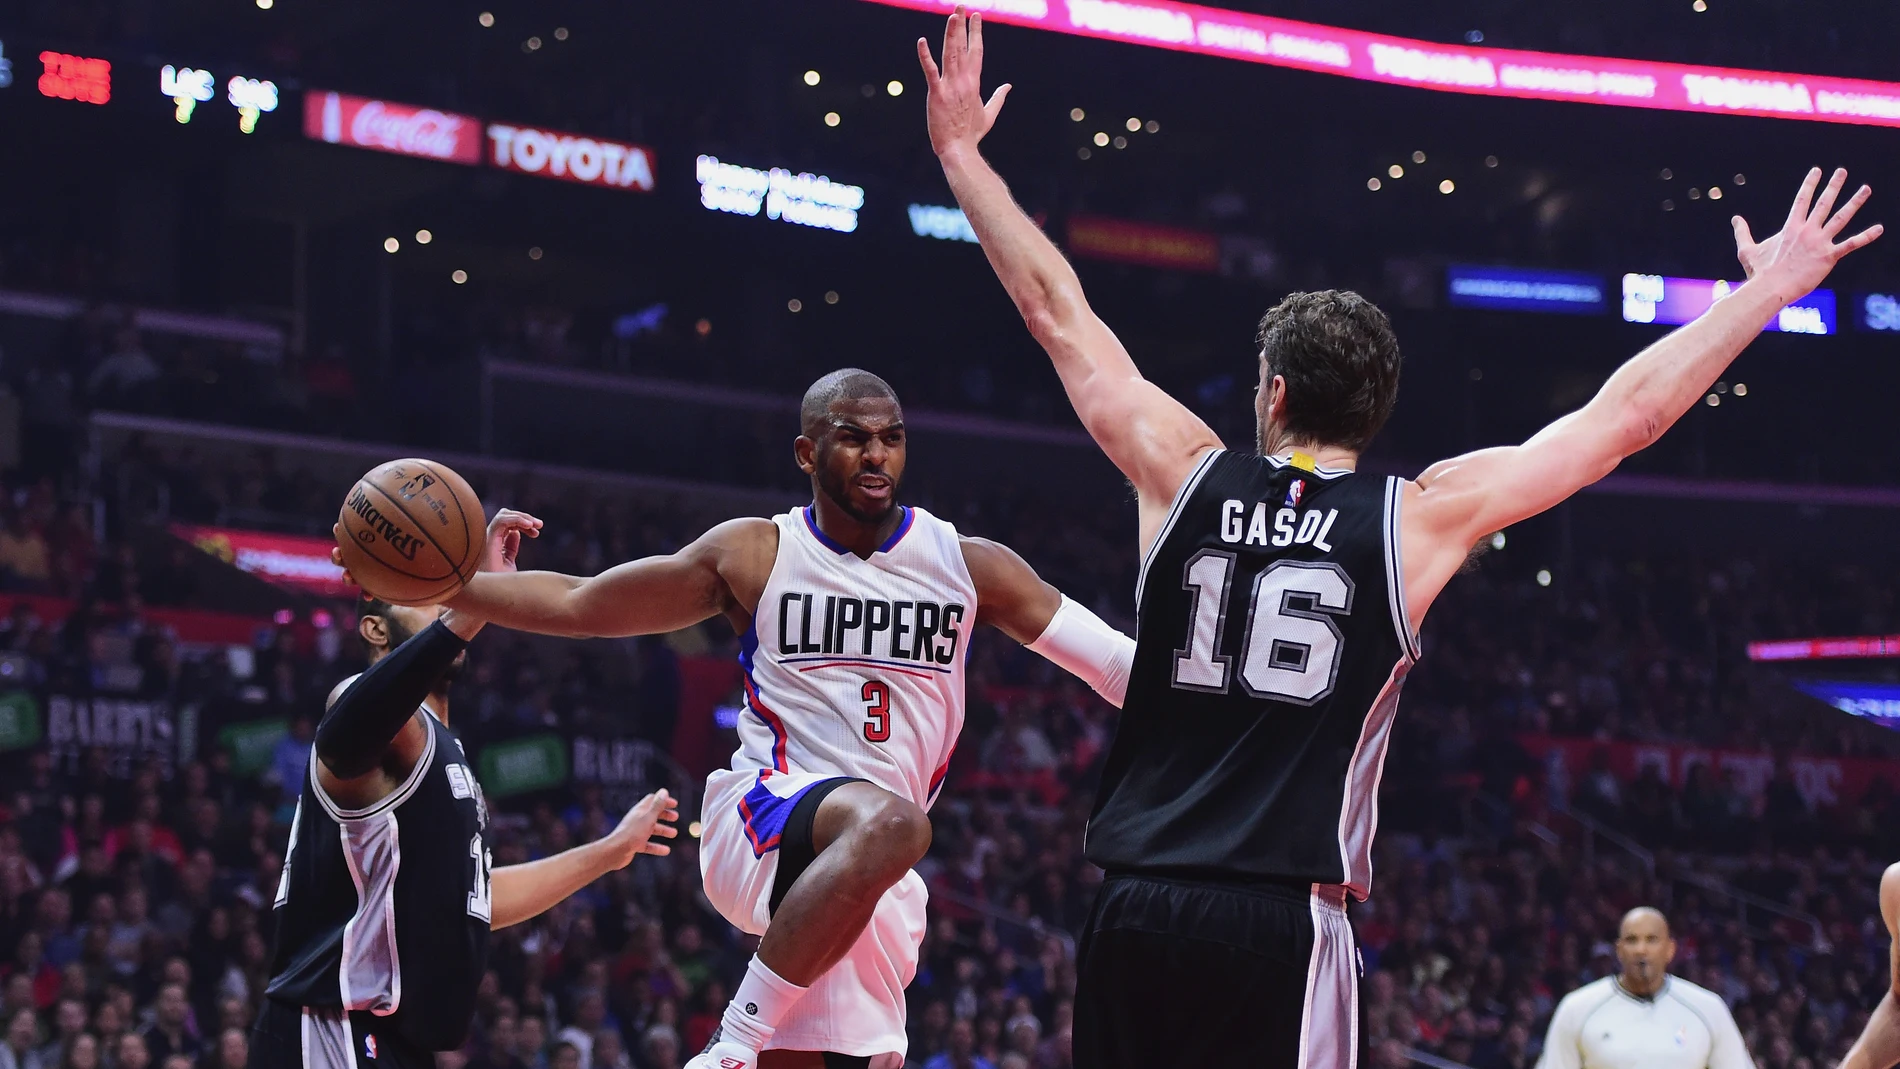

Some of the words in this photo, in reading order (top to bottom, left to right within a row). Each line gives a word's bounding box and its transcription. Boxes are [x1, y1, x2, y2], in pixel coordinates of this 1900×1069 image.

[487, 123, 654, 190] TOYOTA
[348, 486, 425, 561] SPALDING
[1220, 499, 1339, 553] GASOL
[778, 592, 965, 665] CLIPPERS
[1171, 547, 1356, 707] 16
[861, 680, 891, 743] 3
